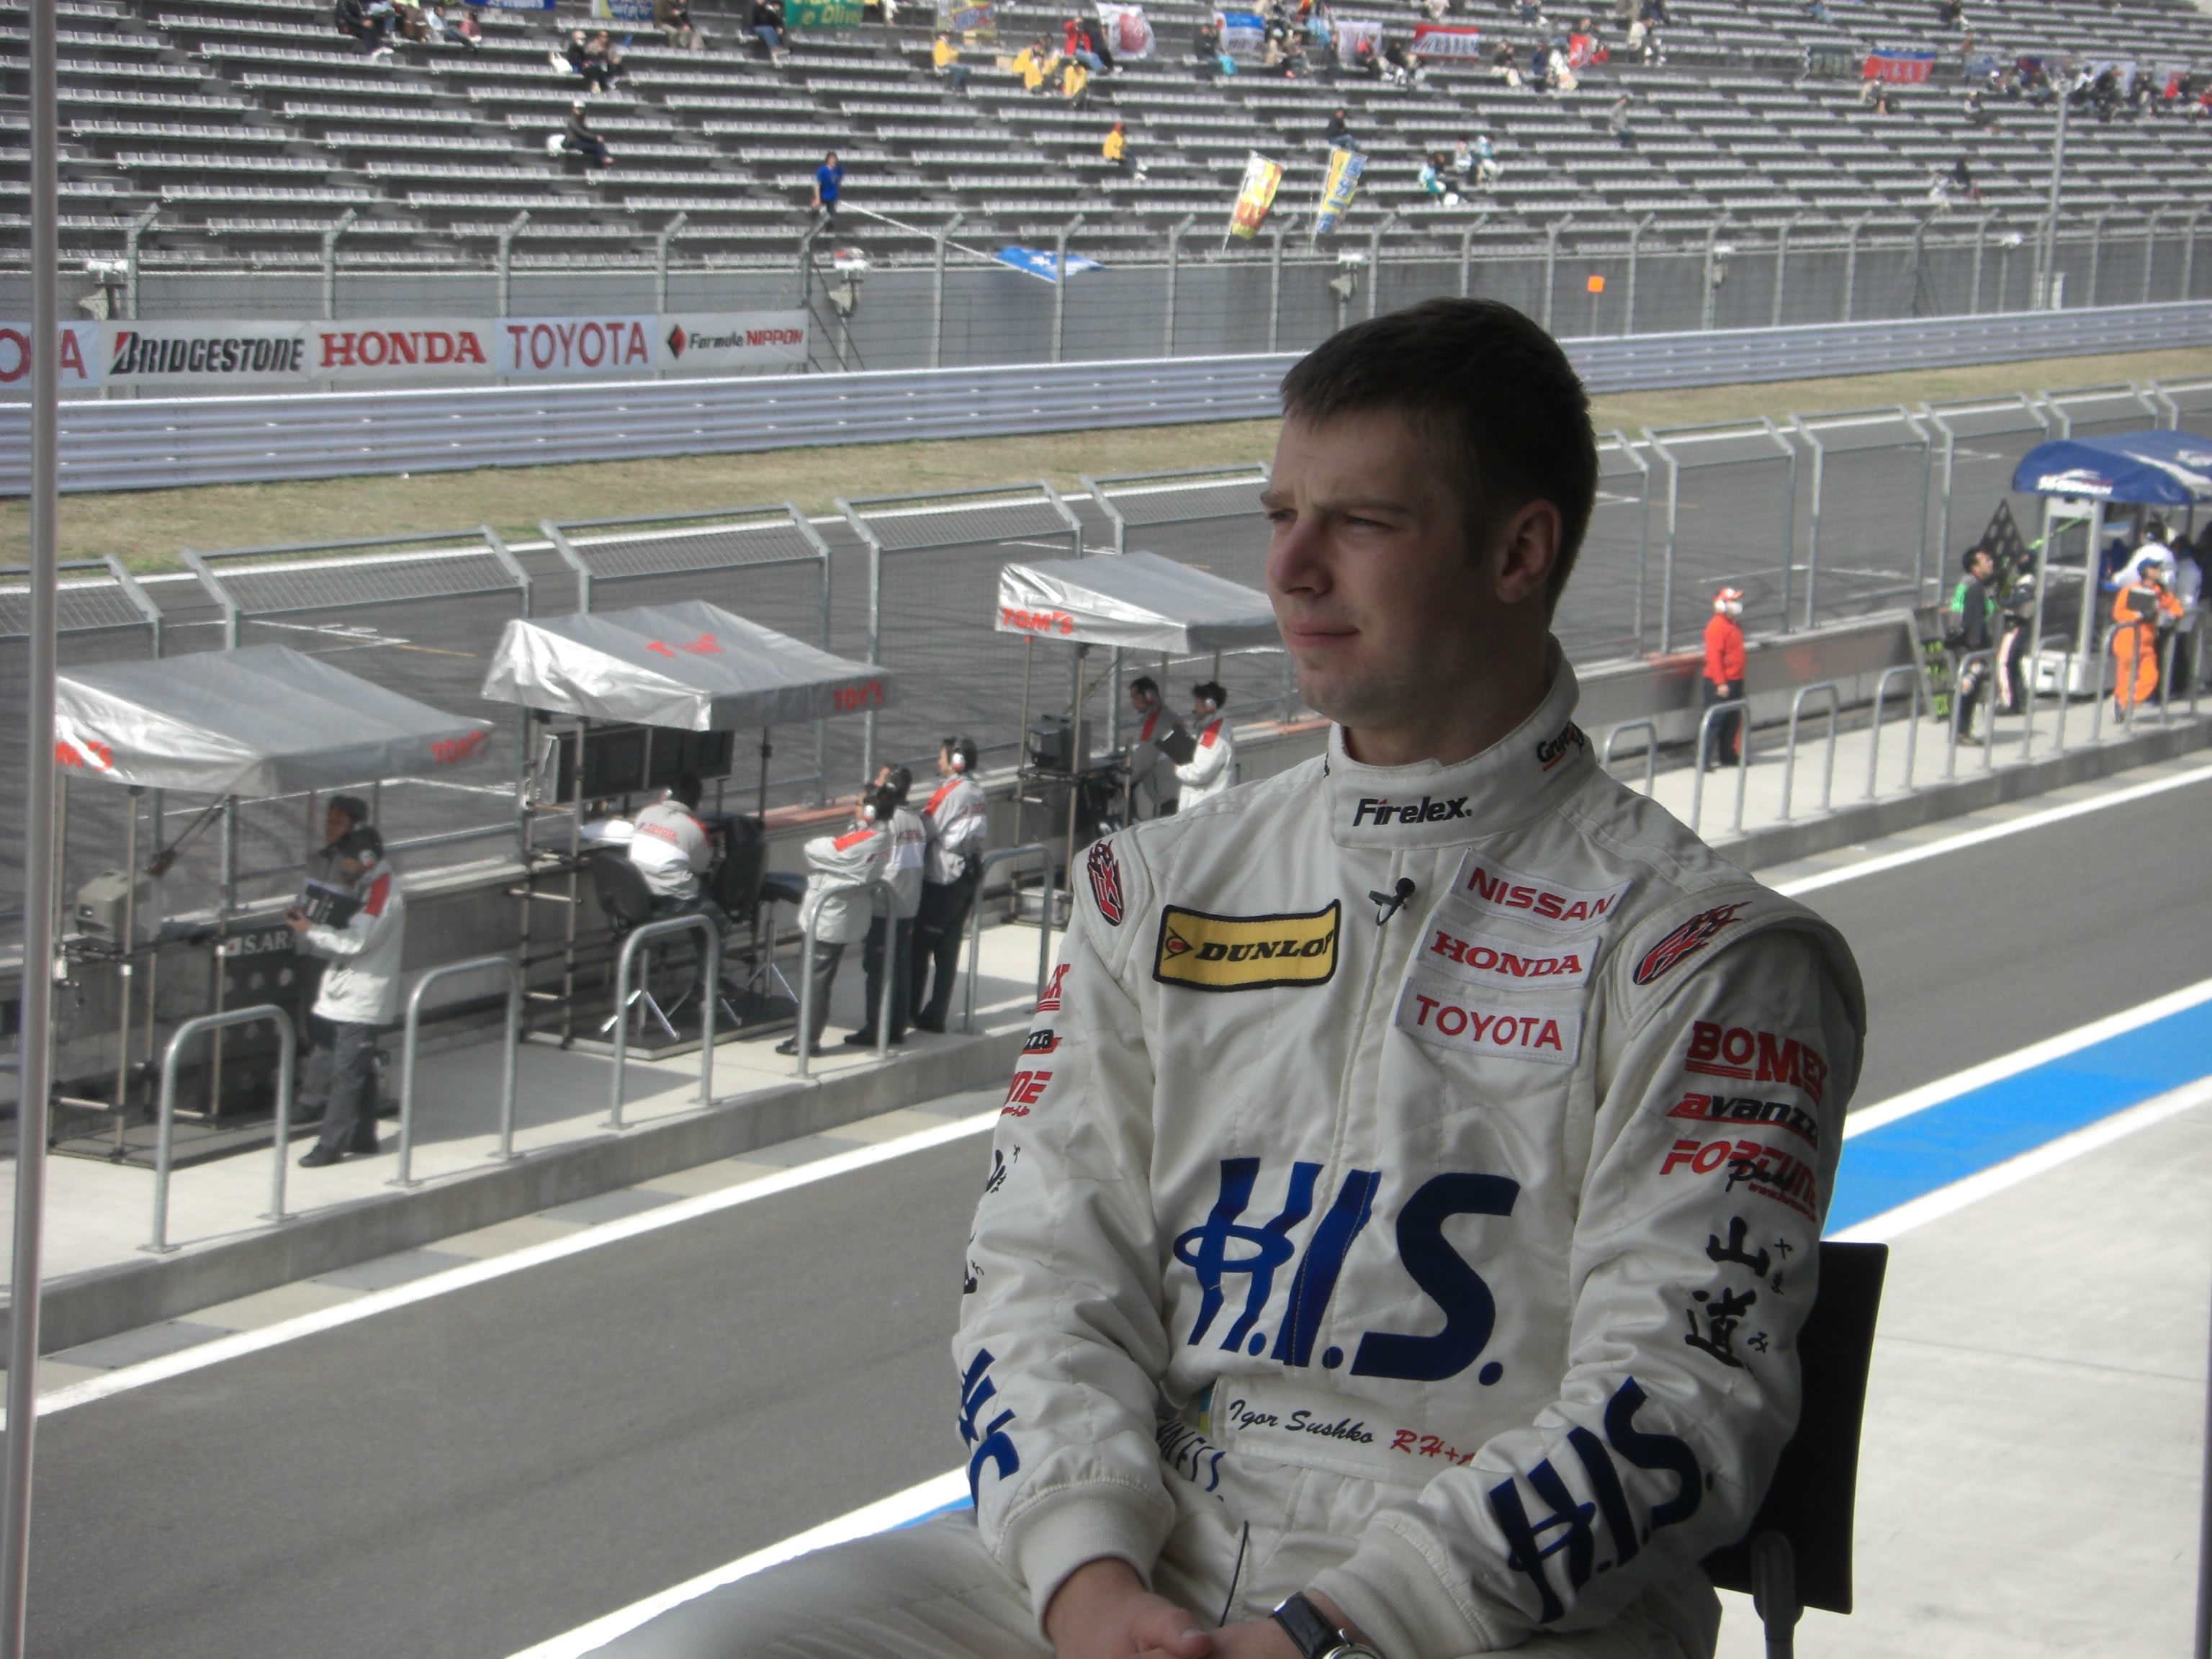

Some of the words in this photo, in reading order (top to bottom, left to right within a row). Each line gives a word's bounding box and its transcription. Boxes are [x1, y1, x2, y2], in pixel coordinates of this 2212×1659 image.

[0, 328, 87, 382] OA
[109, 332, 305, 374] BRIDGESTONE
[320, 332, 487, 368] HONDA
[507, 322, 648, 369] TOYOTA
[688, 331, 744, 349] Formula
[746, 328, 804, 346] NIPPON
[1002, 608, 1074, 634] TOM'S
[1467, 866, 1616, 921] NISSAN
[1430, 930, 1583, 978] HONDA
[1416, 994, 1563, 1051] TOYOTA
[1228, 1399, 1279, 1431] Igor
[1285, 1410, 1374, 1444] Sushko
